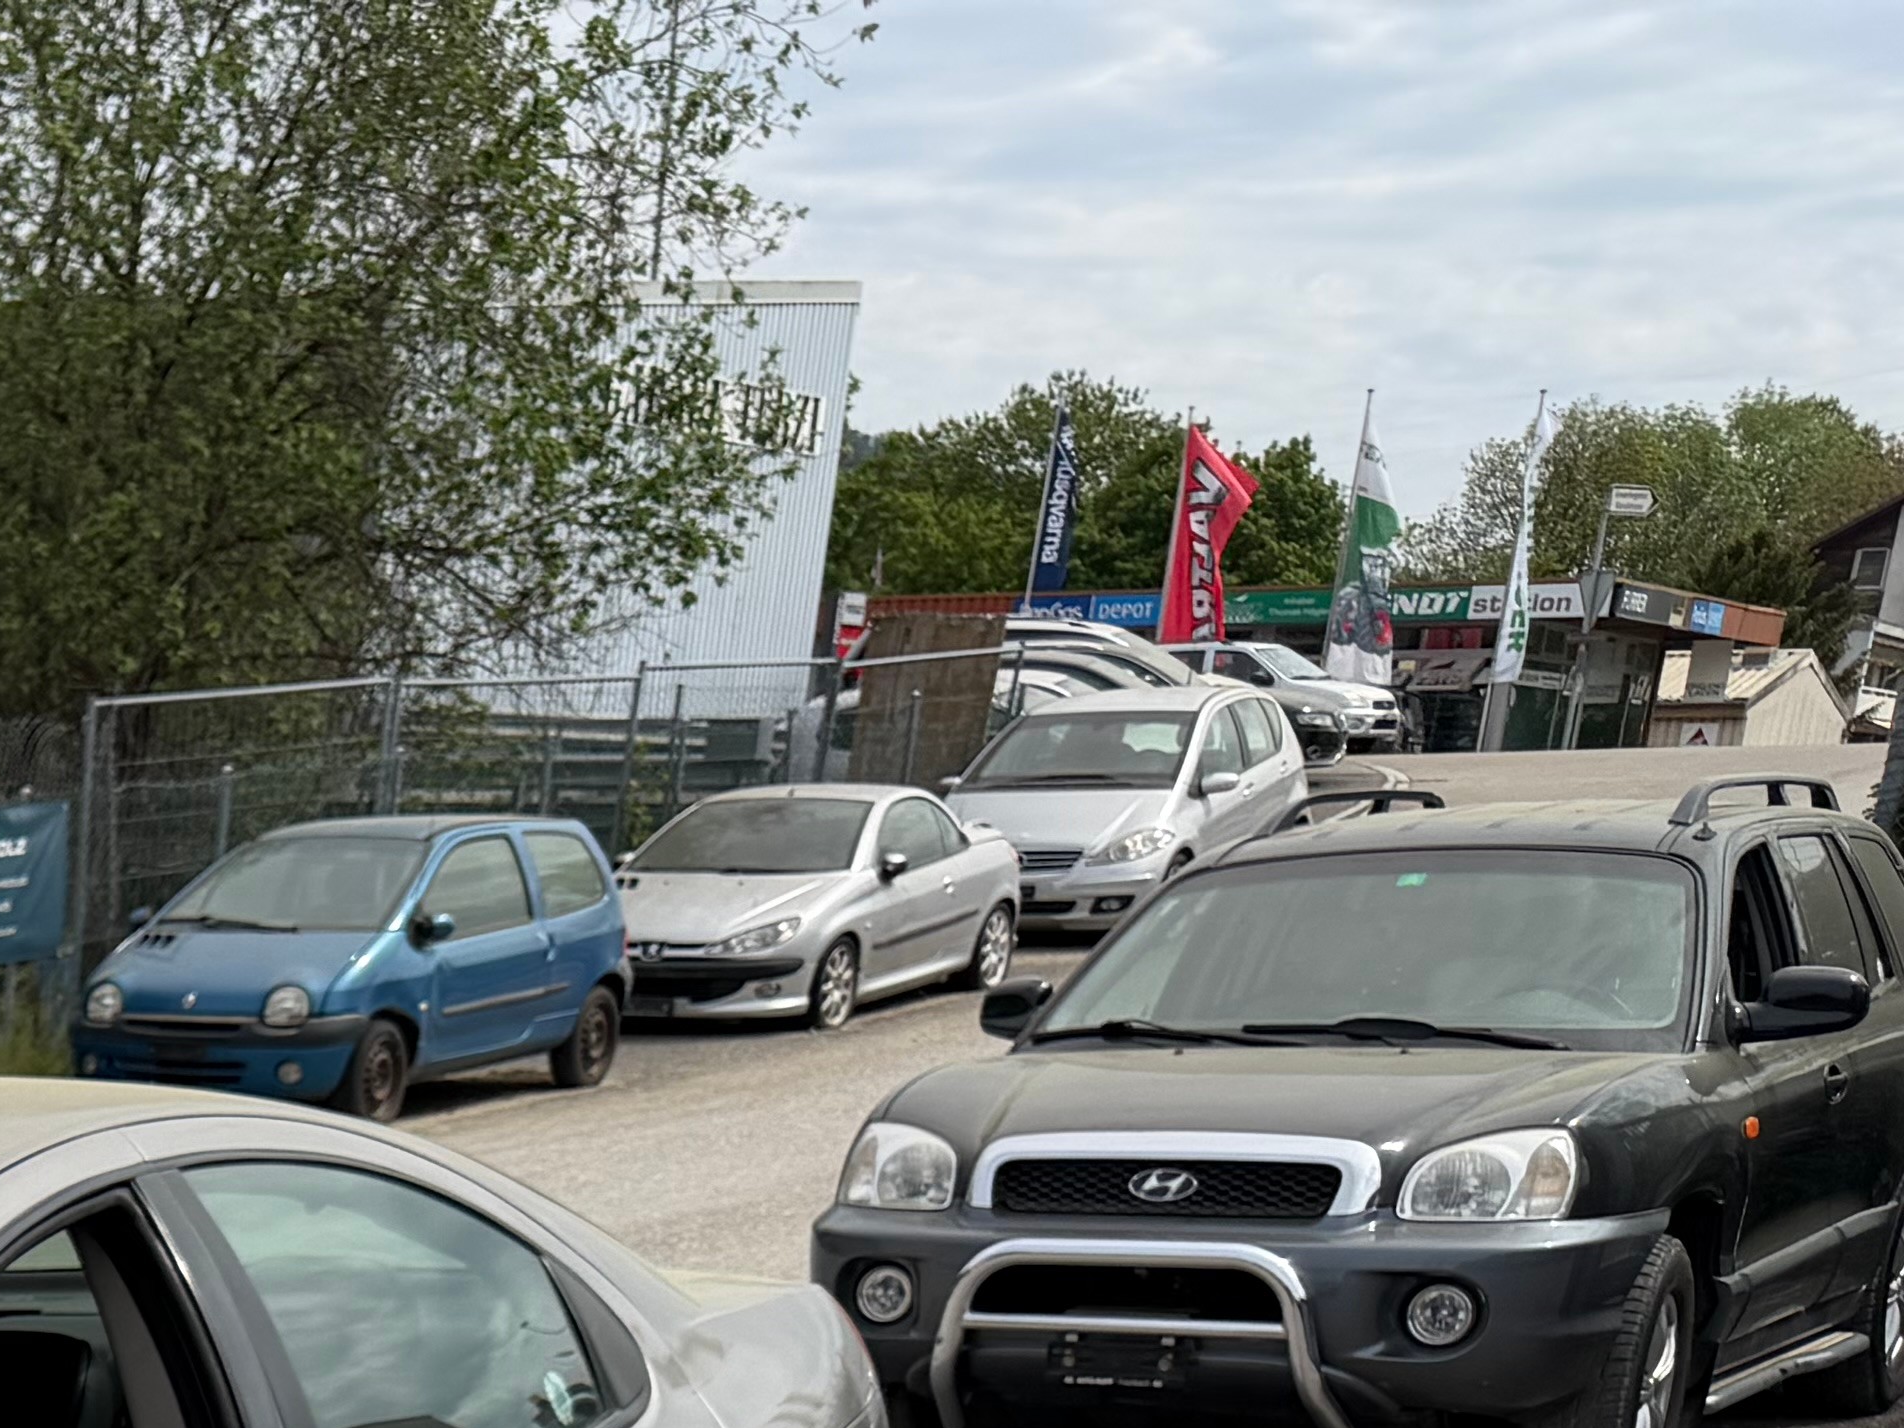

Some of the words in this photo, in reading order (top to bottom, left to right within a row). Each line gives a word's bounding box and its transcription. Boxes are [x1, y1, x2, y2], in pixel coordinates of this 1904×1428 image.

[1041, 460, 1076, 564] usqvarna
[1098, 601, 1154, 620] DEPOT
[1387, 591, 1469, 615] NDT
[1473, 593, 1572, 613] stion
